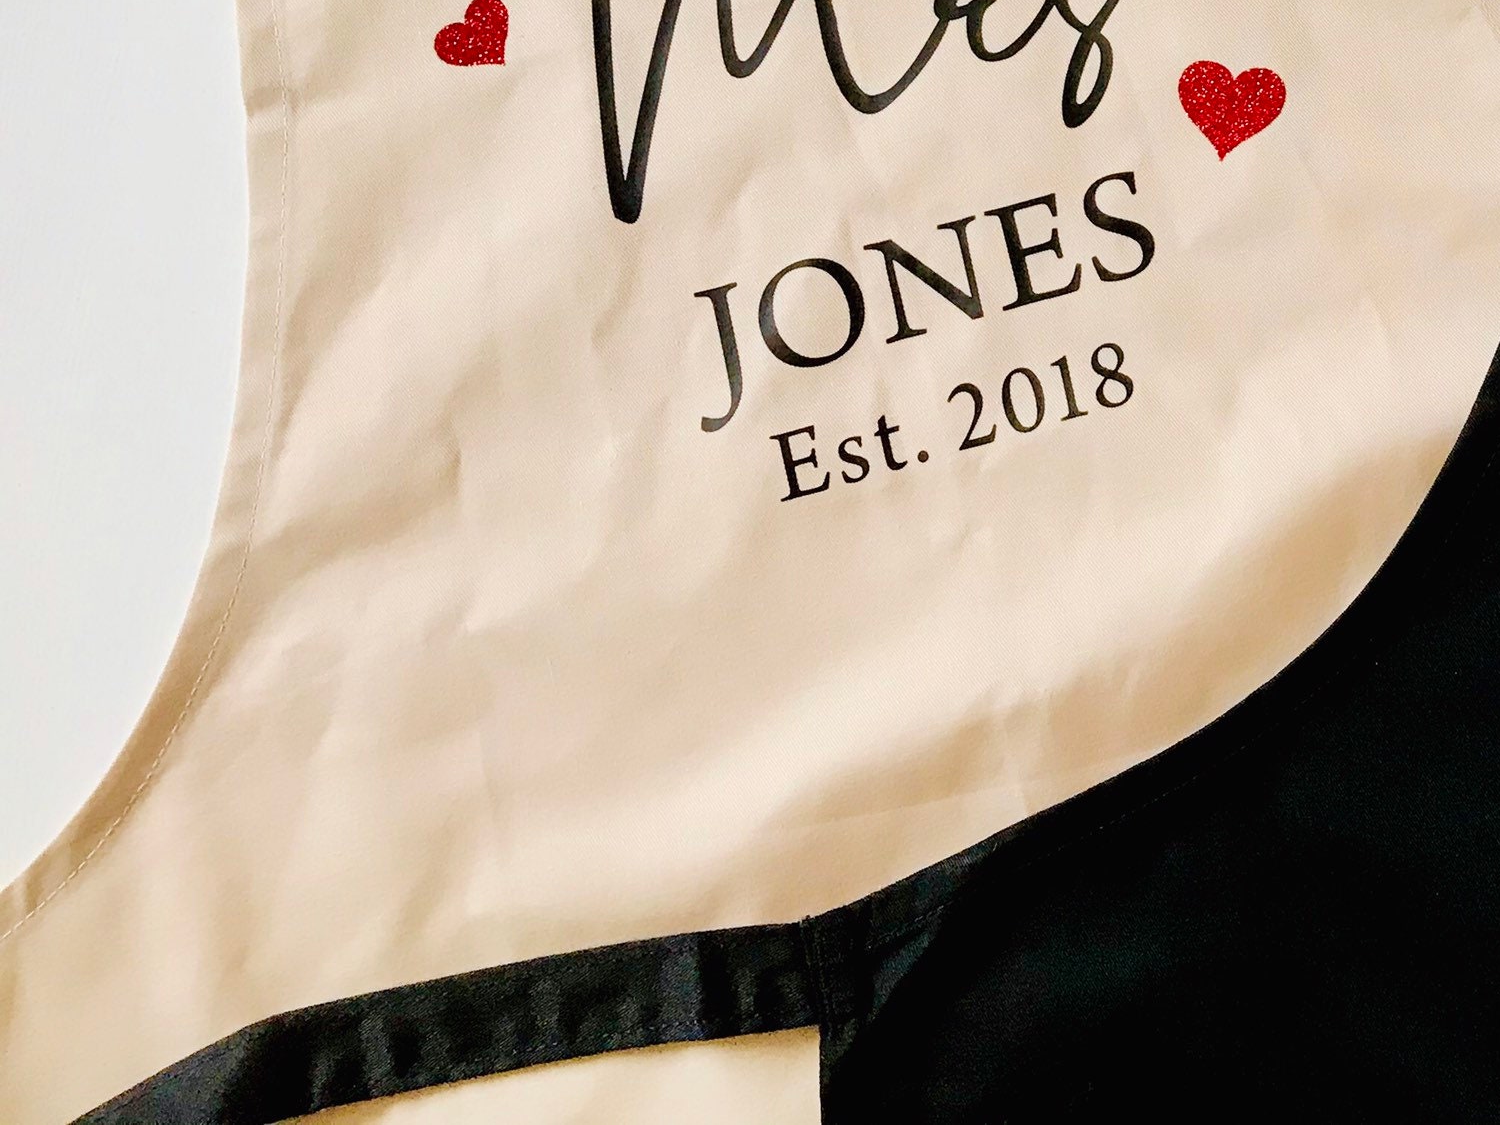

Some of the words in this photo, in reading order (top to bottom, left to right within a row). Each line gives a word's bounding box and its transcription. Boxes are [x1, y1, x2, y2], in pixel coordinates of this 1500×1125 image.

[693, 171, 1156, 433] JONES
[769, 414, 930, 503] Est.
[947, 342, 1134, 451] 2018
